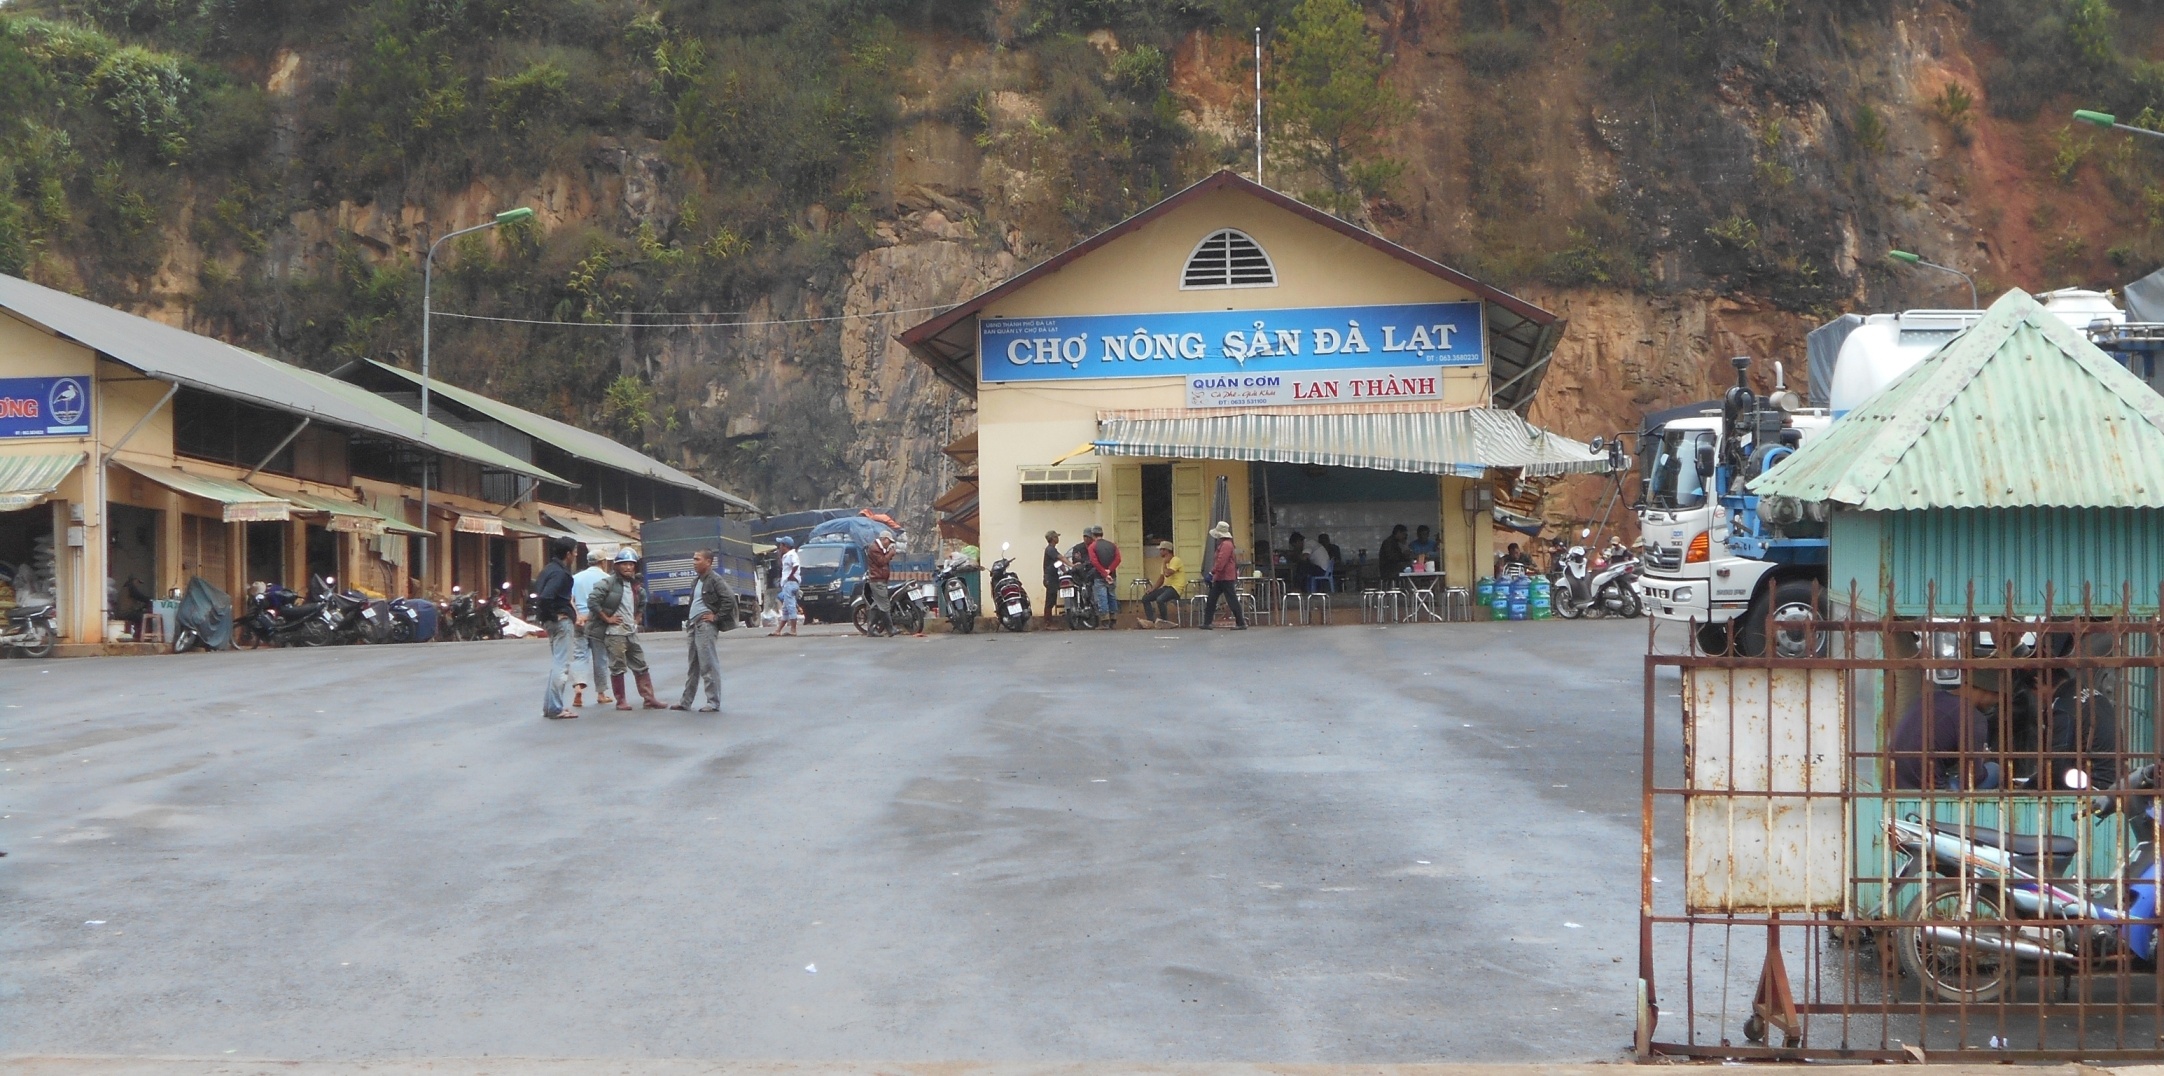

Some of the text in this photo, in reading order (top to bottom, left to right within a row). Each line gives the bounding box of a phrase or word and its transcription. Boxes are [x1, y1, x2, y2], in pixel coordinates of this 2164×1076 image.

[1007, 319, 1457, 369] CHỢ NÔNG SẢN ĐÀ LẠT
[1243, 375, 1280, 387] CƠM
[1292, 374, 1436, 399] LAN THÀNH
